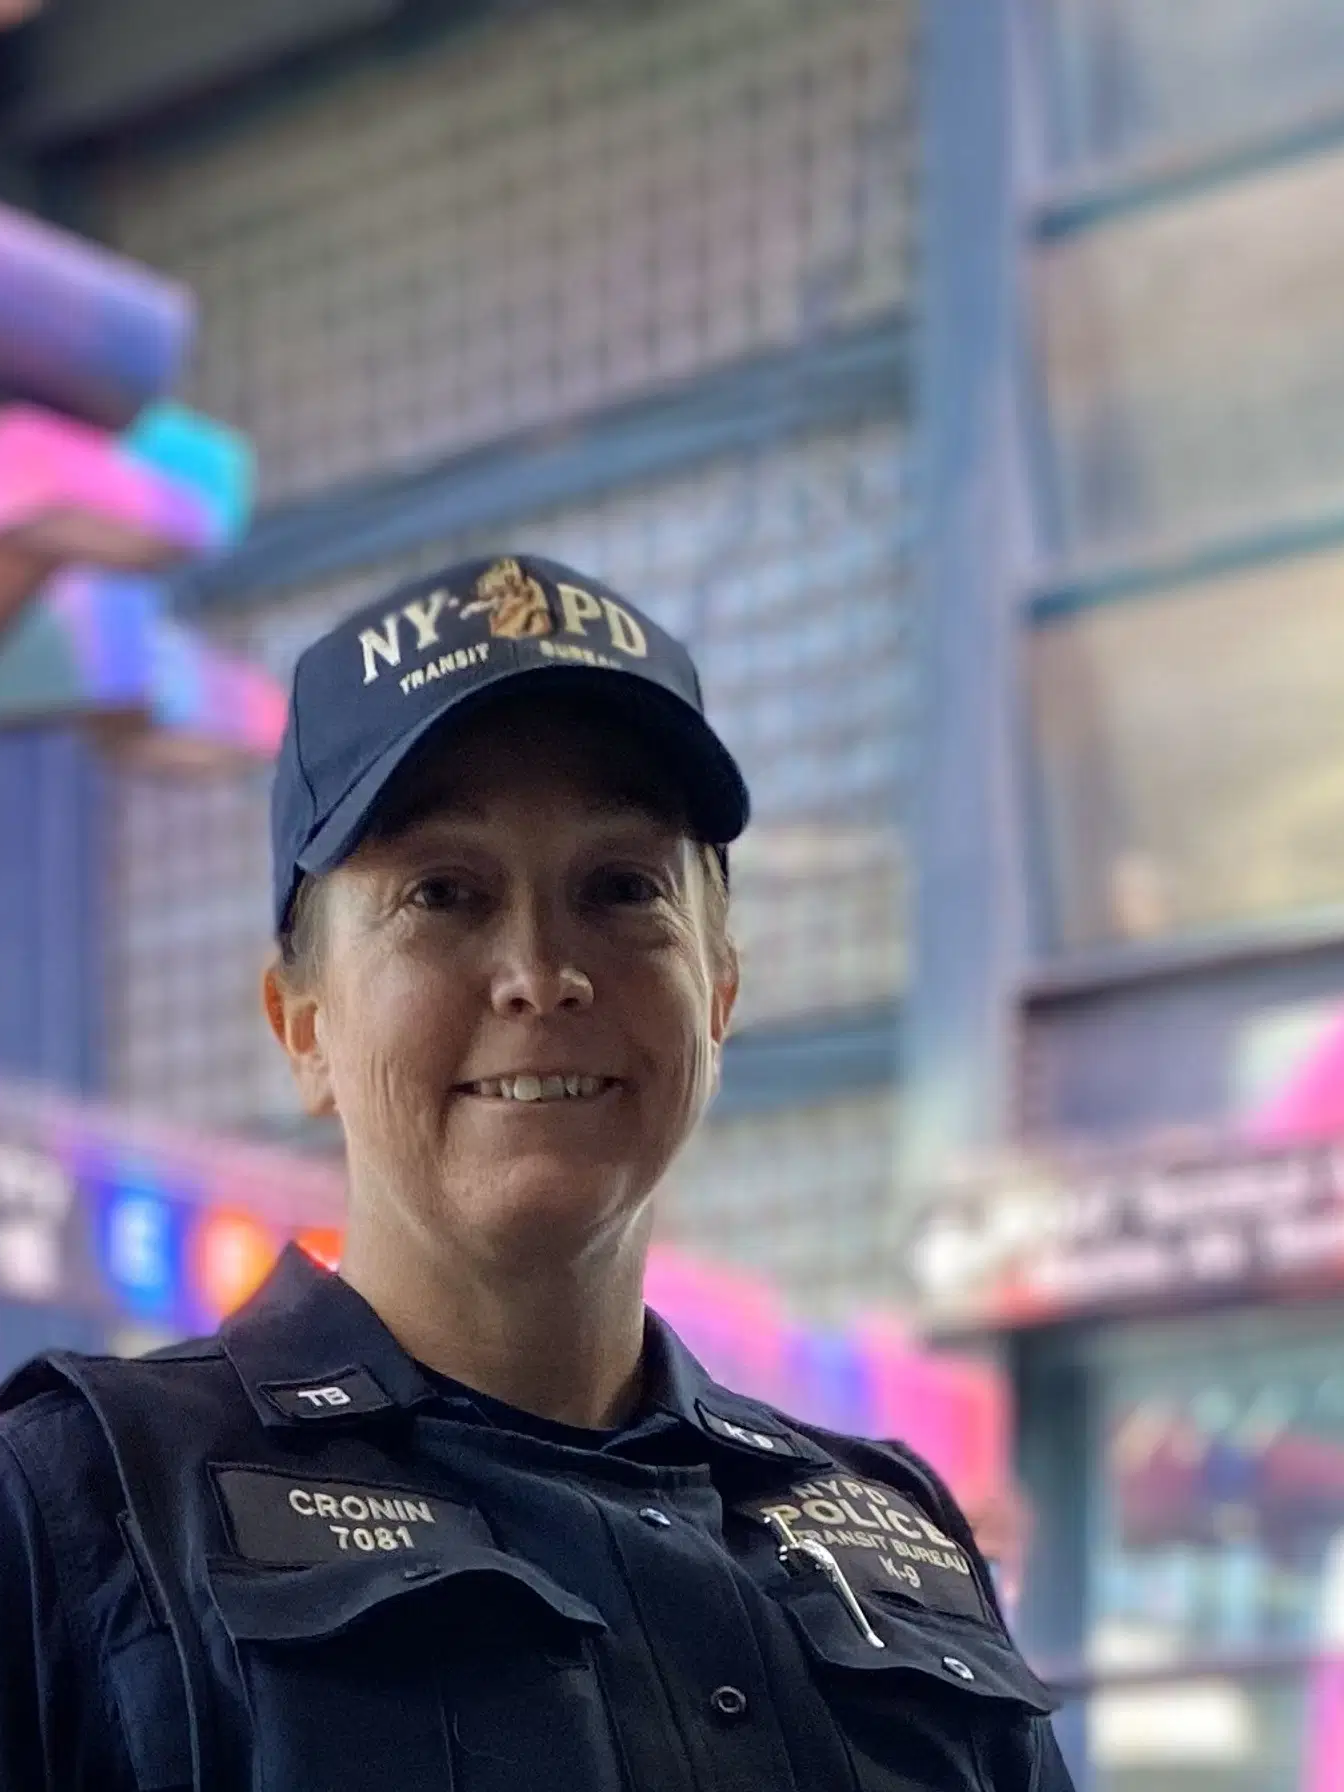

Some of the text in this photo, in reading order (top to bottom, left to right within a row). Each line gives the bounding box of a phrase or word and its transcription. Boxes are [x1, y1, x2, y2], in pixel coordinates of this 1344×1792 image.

[399, 643, 490, 695] TRANSIT
[298, 1387, 351, 1407] TB
[289, 1489, 437, 1524] CRONIN
[791, 1479, 888, 1506] NYPD
[330, 1525, 416, 1552] 7081
[760, 1498, 957, 1549] POLICE
[892, 1538, 970, 1576] BUREAU
